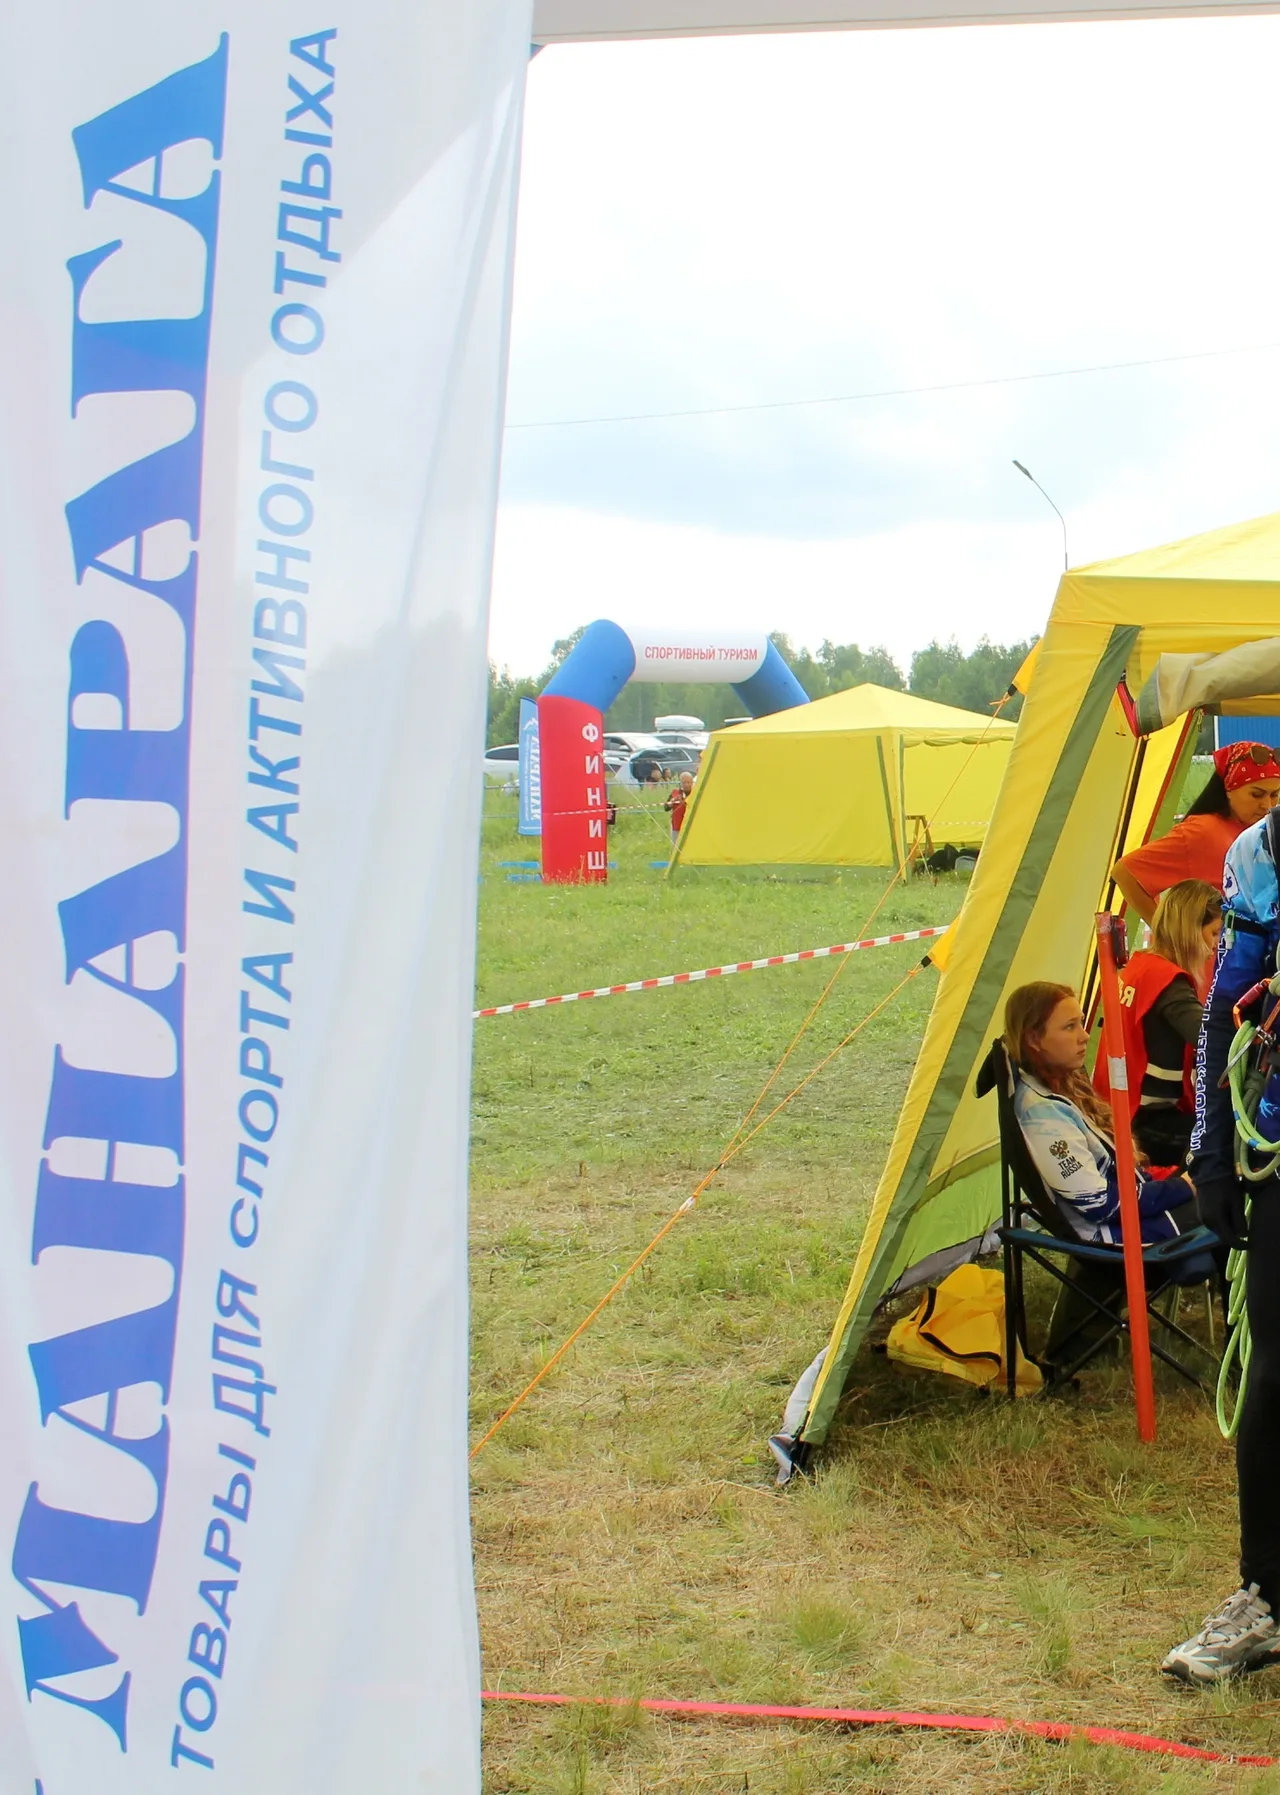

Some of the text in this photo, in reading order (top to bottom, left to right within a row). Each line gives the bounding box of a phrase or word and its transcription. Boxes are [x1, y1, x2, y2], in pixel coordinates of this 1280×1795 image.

[644, 645, 758, 661] СПОРТИВНЫЙ ТУРИЗМ
[9, 31, 229, 1754] МАНАРАГА
[170, 27, 343, 1770] ТОВАРЫ ДЛЯ СПОРТА И АКТИВНОГО ОТДЫХА
[1058, 1155, 1077, 1171] TEAM
[1060, 1161, 1084, 1180] RUSSIA
